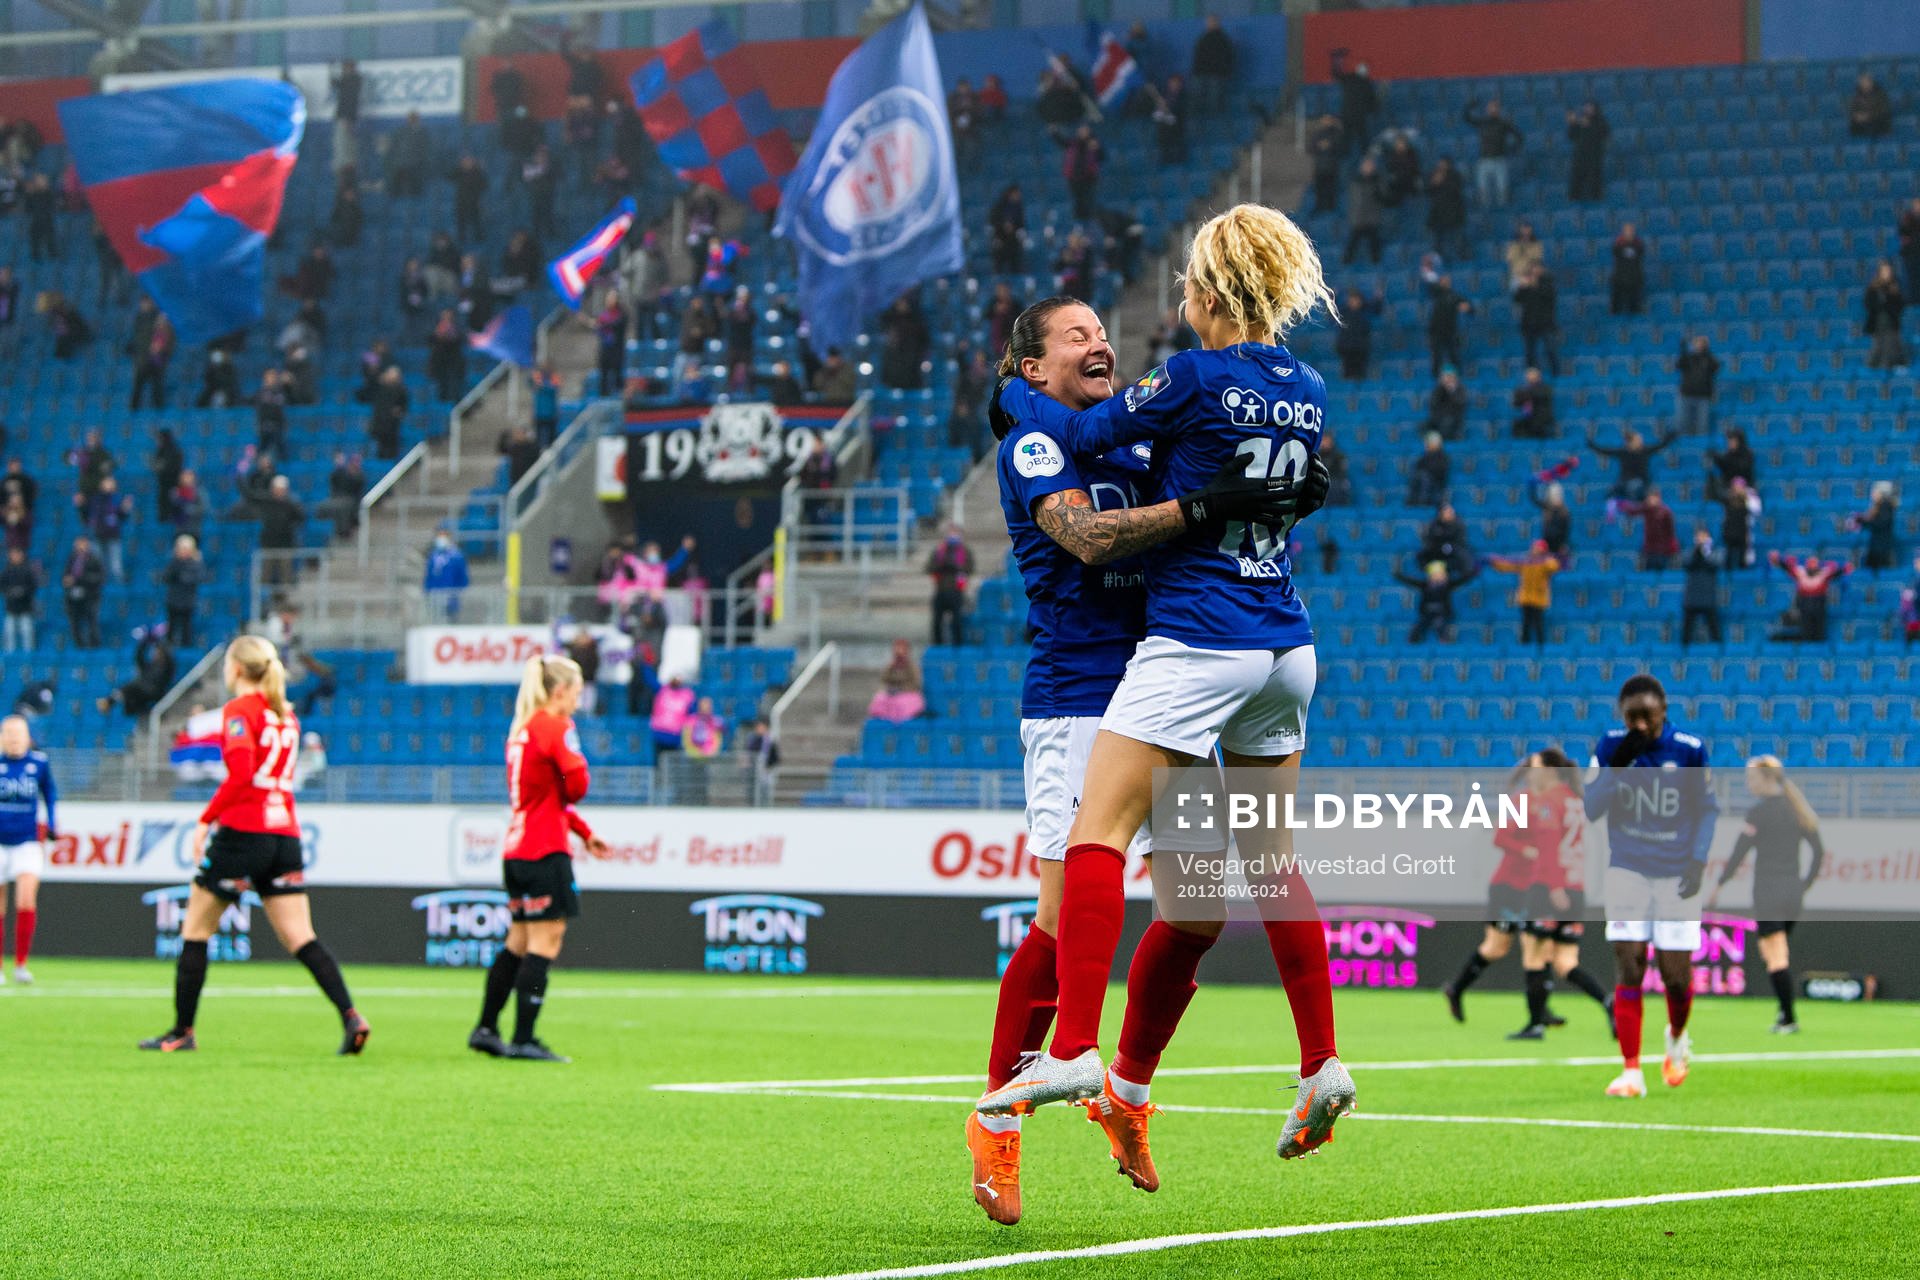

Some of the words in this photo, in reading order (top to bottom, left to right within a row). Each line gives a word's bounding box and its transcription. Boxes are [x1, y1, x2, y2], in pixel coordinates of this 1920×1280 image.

[1273, 401, 1322, 433] OBOS
[640, 429, 693, 481] 19
[1027, 457, 1058, 470] OBOS
[1266, 727, 1300, 738] umbro
[252, 726, 299, 792] 22
[1617, 777, 1680, 824] DNB
[40, 821, 131, 866] axi
[686, 836, 784, 866] Bestill
[705, 902, 807, 943] THON
[1322, 918, 1418, 957] HON
[704, 944, 807, 974] HOTELS
[1329, 958, 1418, 988] OTELS
